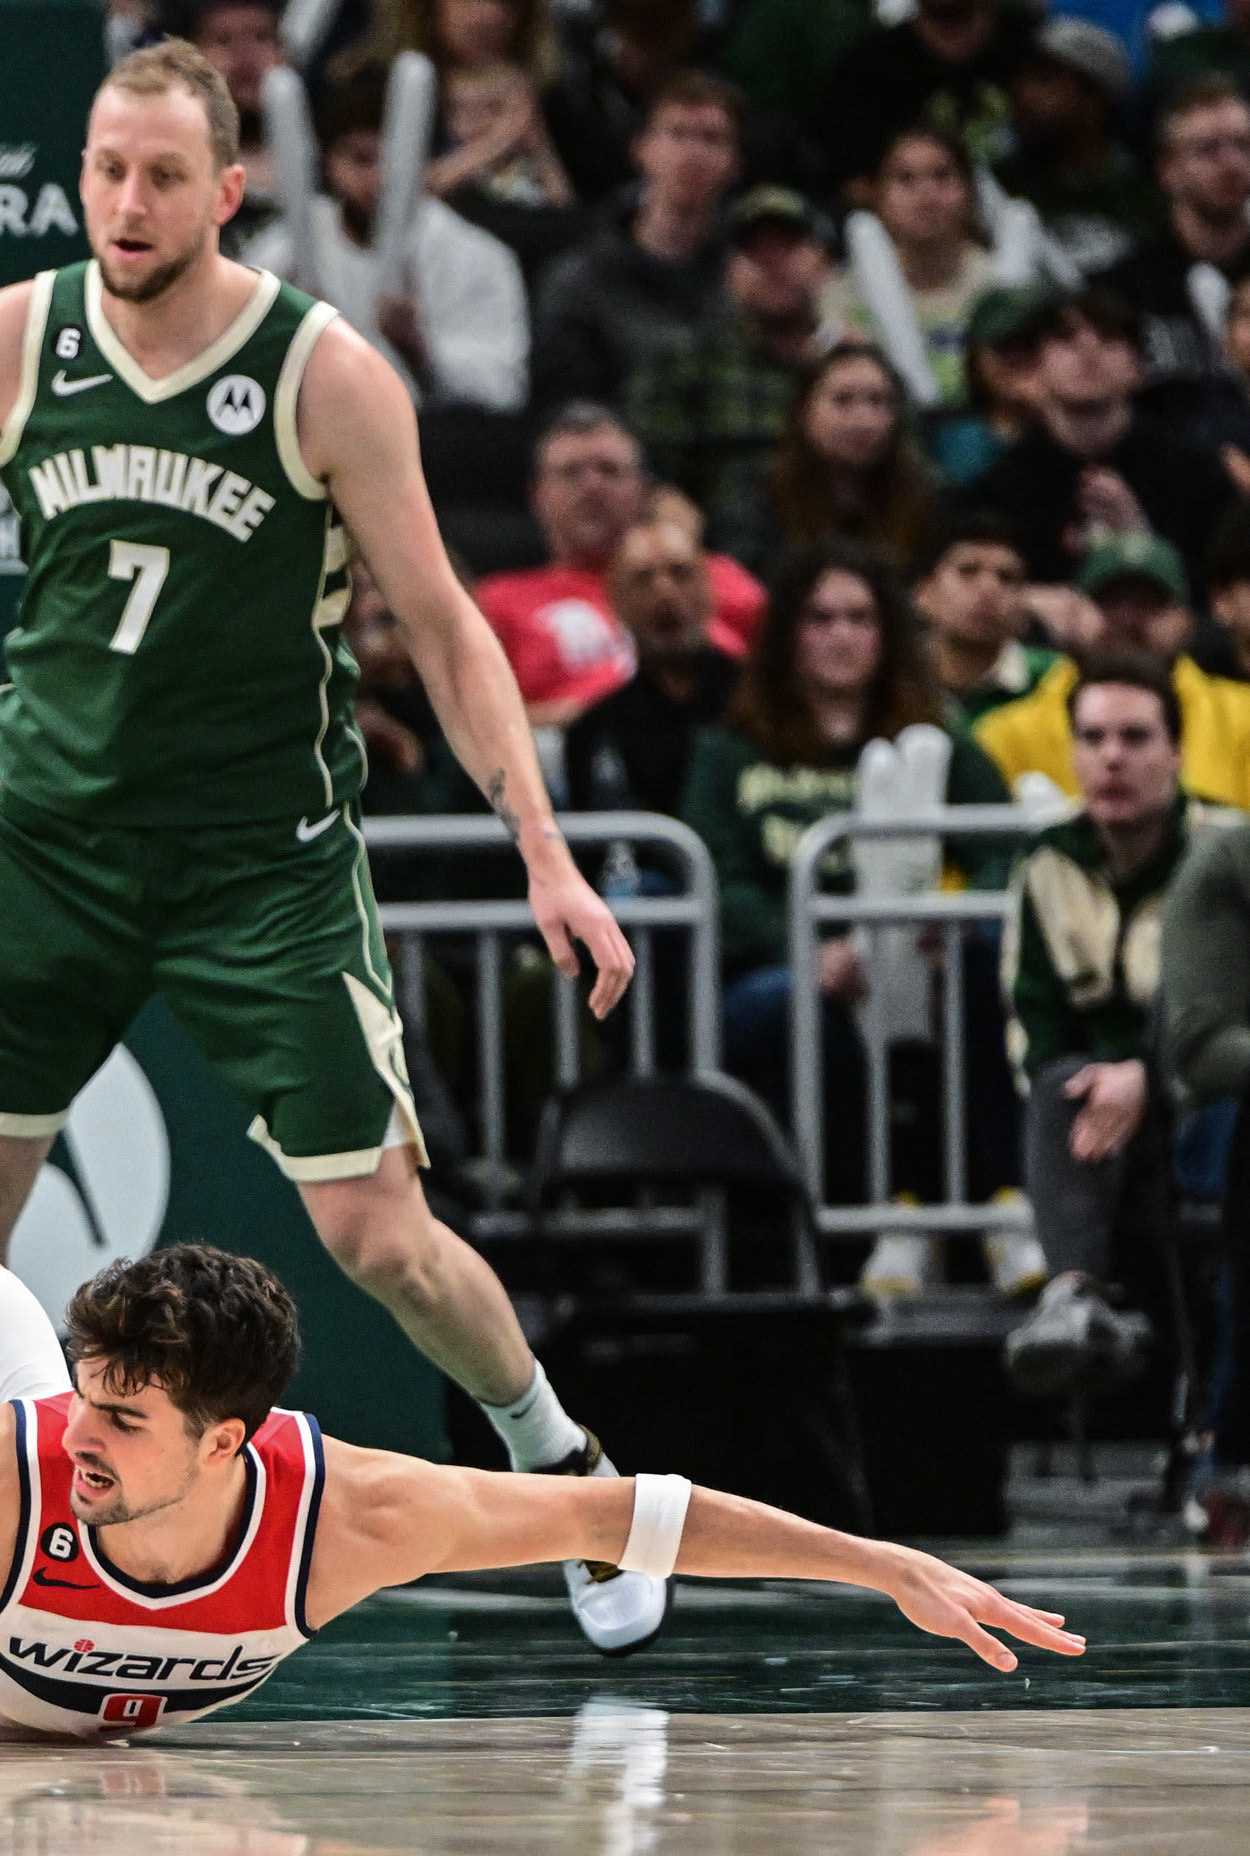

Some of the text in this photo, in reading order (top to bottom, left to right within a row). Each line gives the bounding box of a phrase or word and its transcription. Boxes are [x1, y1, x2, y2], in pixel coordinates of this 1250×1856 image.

[56, 327, 81, 360] 6
[28, 443, 277, 543] MILWAUKEE
[107, 538, 171, 655] 7
[50, 1527, 74, 1559] 6
[8, 1635, 282, 1681] wizards
[100, 1692, 168, 1732] 9
